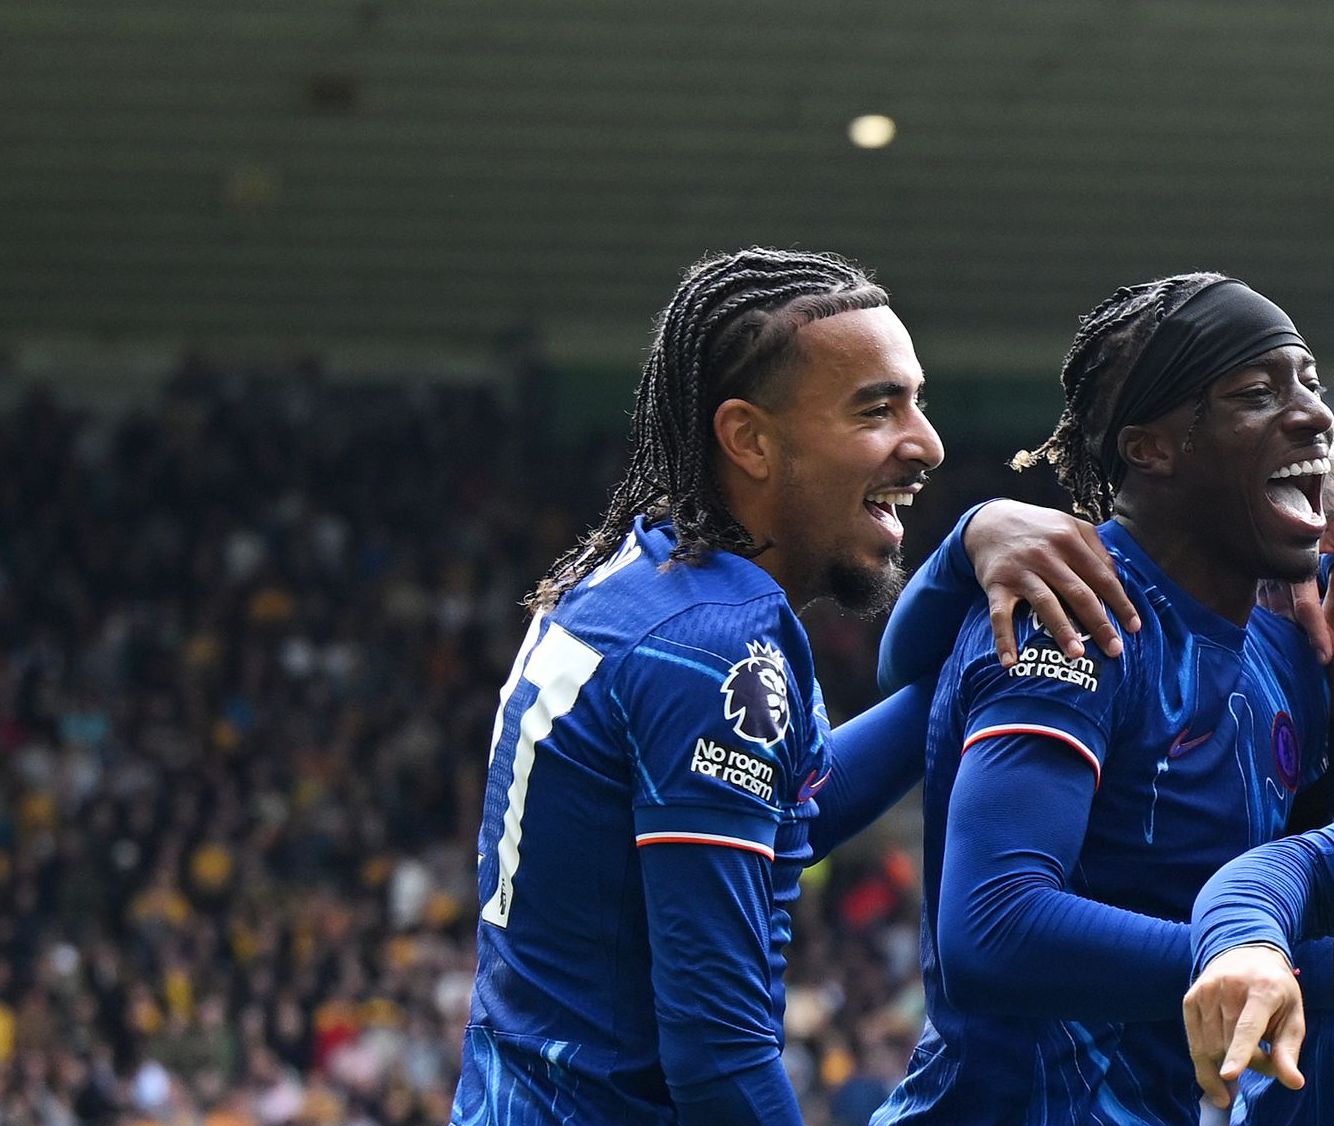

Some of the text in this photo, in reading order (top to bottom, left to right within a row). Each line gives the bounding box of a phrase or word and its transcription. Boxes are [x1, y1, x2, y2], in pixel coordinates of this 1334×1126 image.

[1036, 663, 1098, 693] racism
[690, 754, 773, 802] for racism
[693, 737, 774, 783] No room
